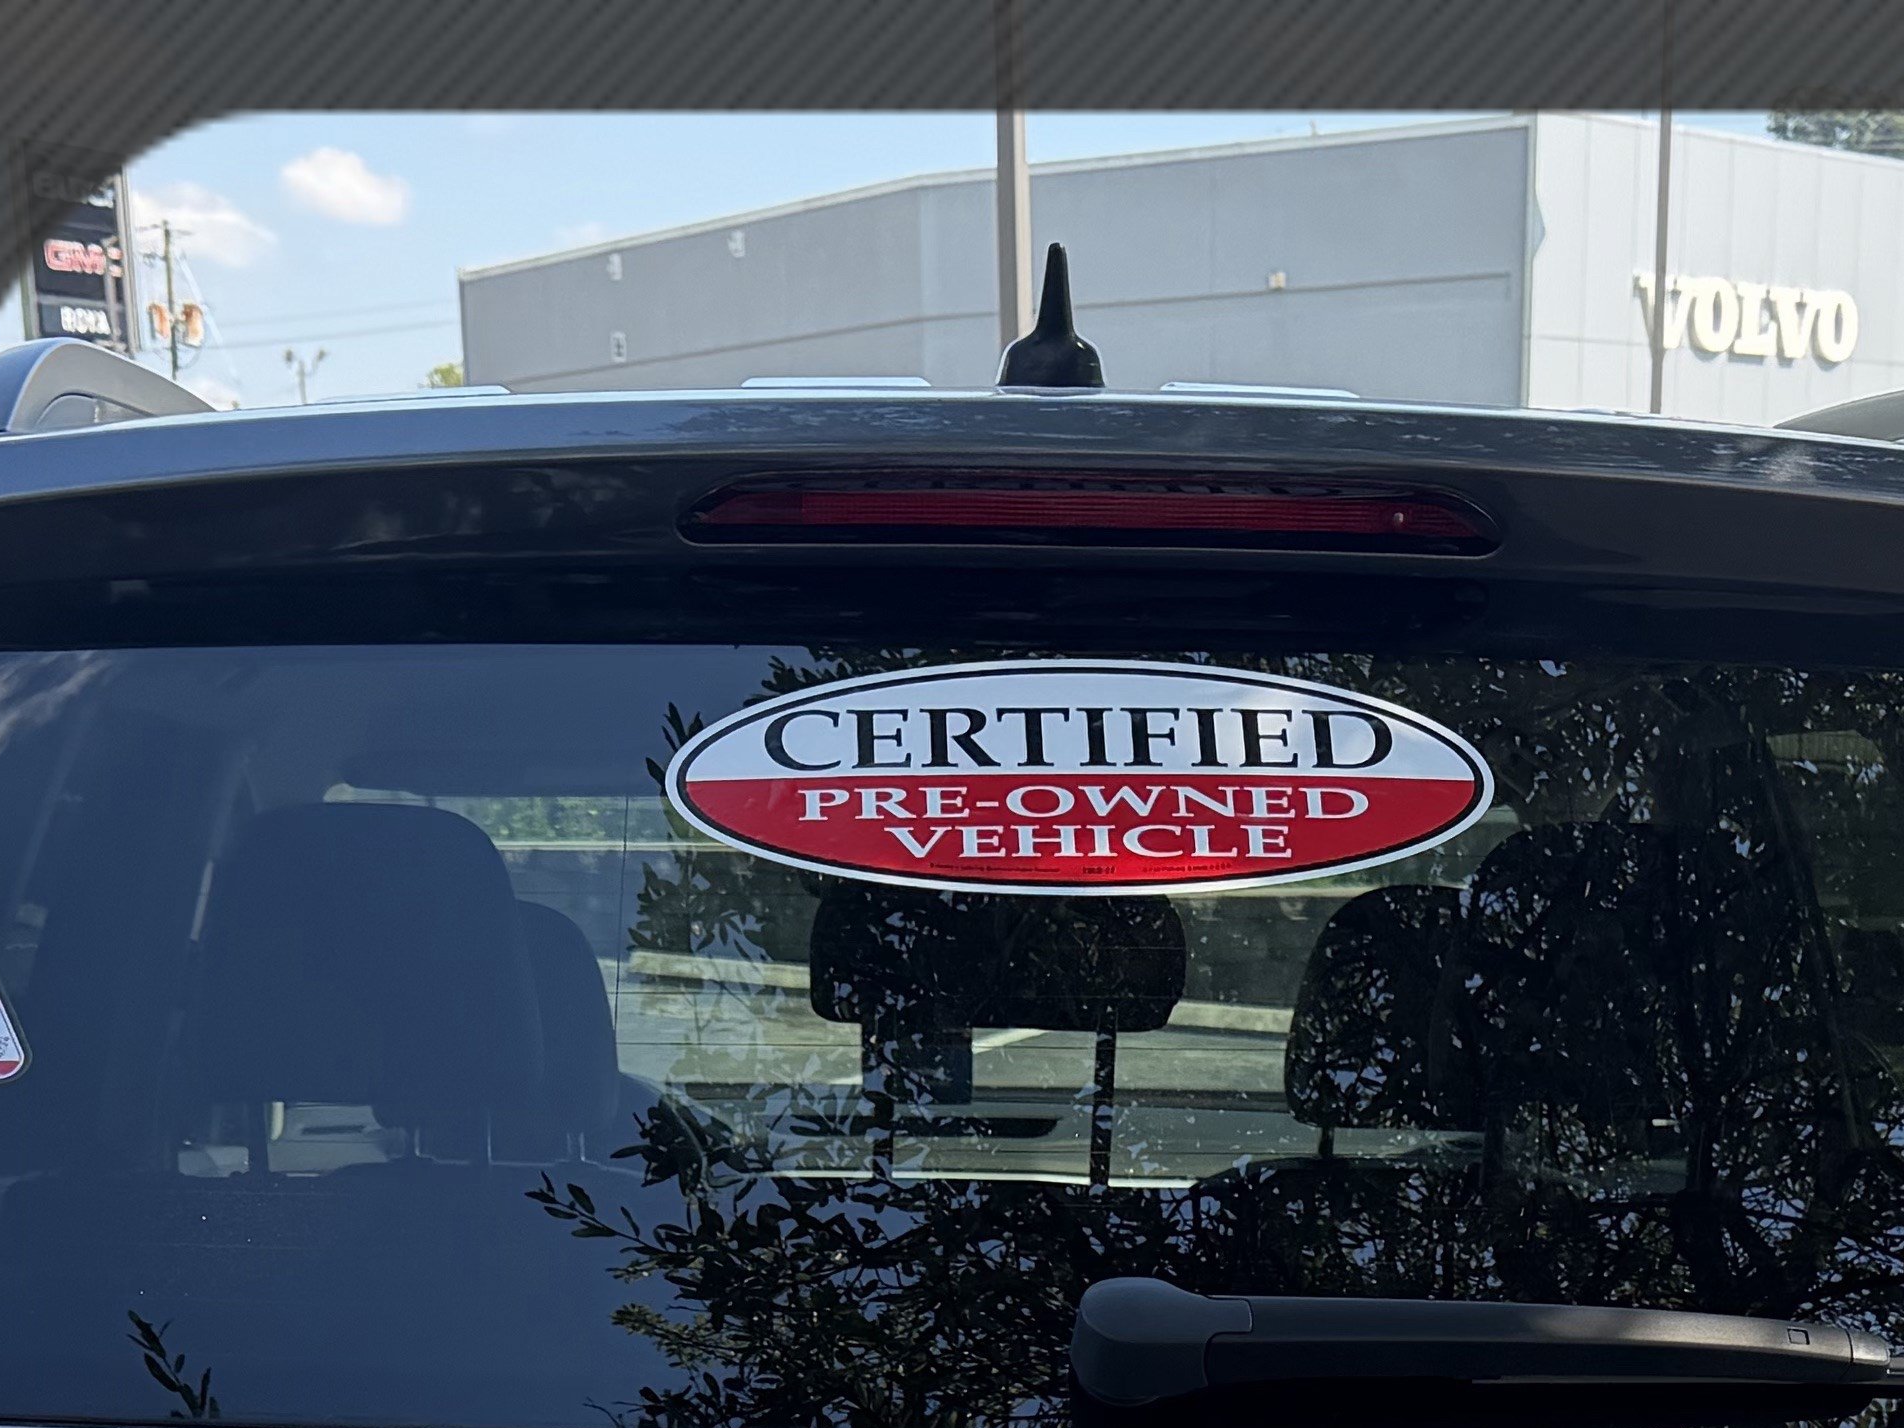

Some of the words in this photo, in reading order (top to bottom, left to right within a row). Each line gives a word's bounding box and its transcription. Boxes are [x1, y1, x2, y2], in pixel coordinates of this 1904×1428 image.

[1632, 270, 1859, 362] VOLVO
[763, 706, 1394, 772] CERTIFIED
[797, 784, 1370, 822] PRE-OWNED
[884, 824, 1293, 859] VEHICLE
